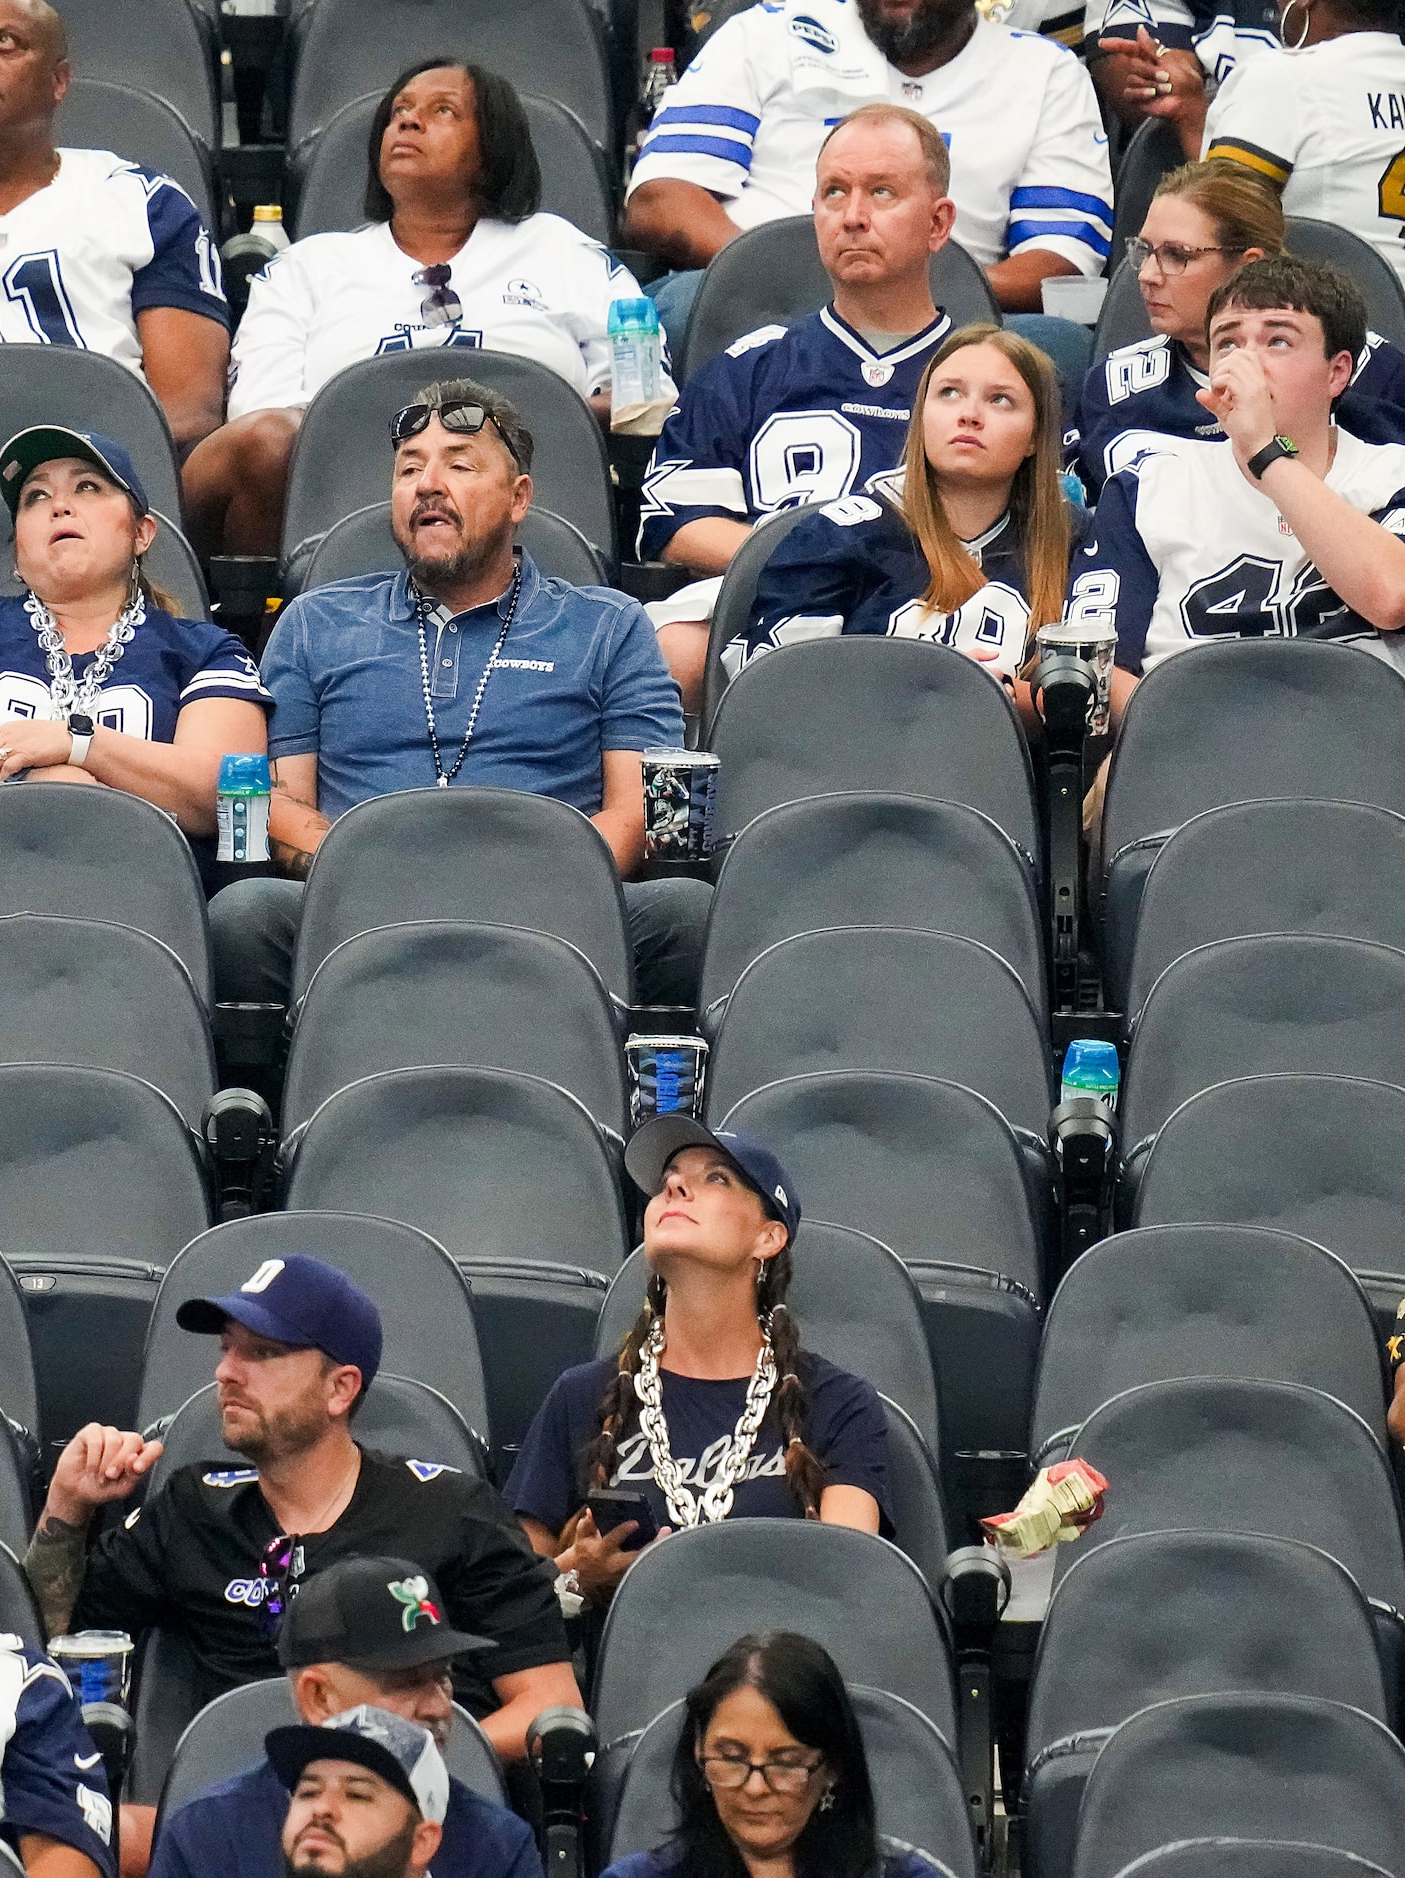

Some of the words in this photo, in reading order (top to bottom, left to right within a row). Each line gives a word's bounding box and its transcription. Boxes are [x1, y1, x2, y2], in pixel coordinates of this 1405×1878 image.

[792, 24, 836, 47] PEPSI
[492, 659, 554, 673] COWBOYS
[656, 1052, 680, 1114] WBOYS
[32, 1278, 44, 1289] 13
[241, 1260, 285, 1293] D
[609, 1431, 787, 1489] Dalas
